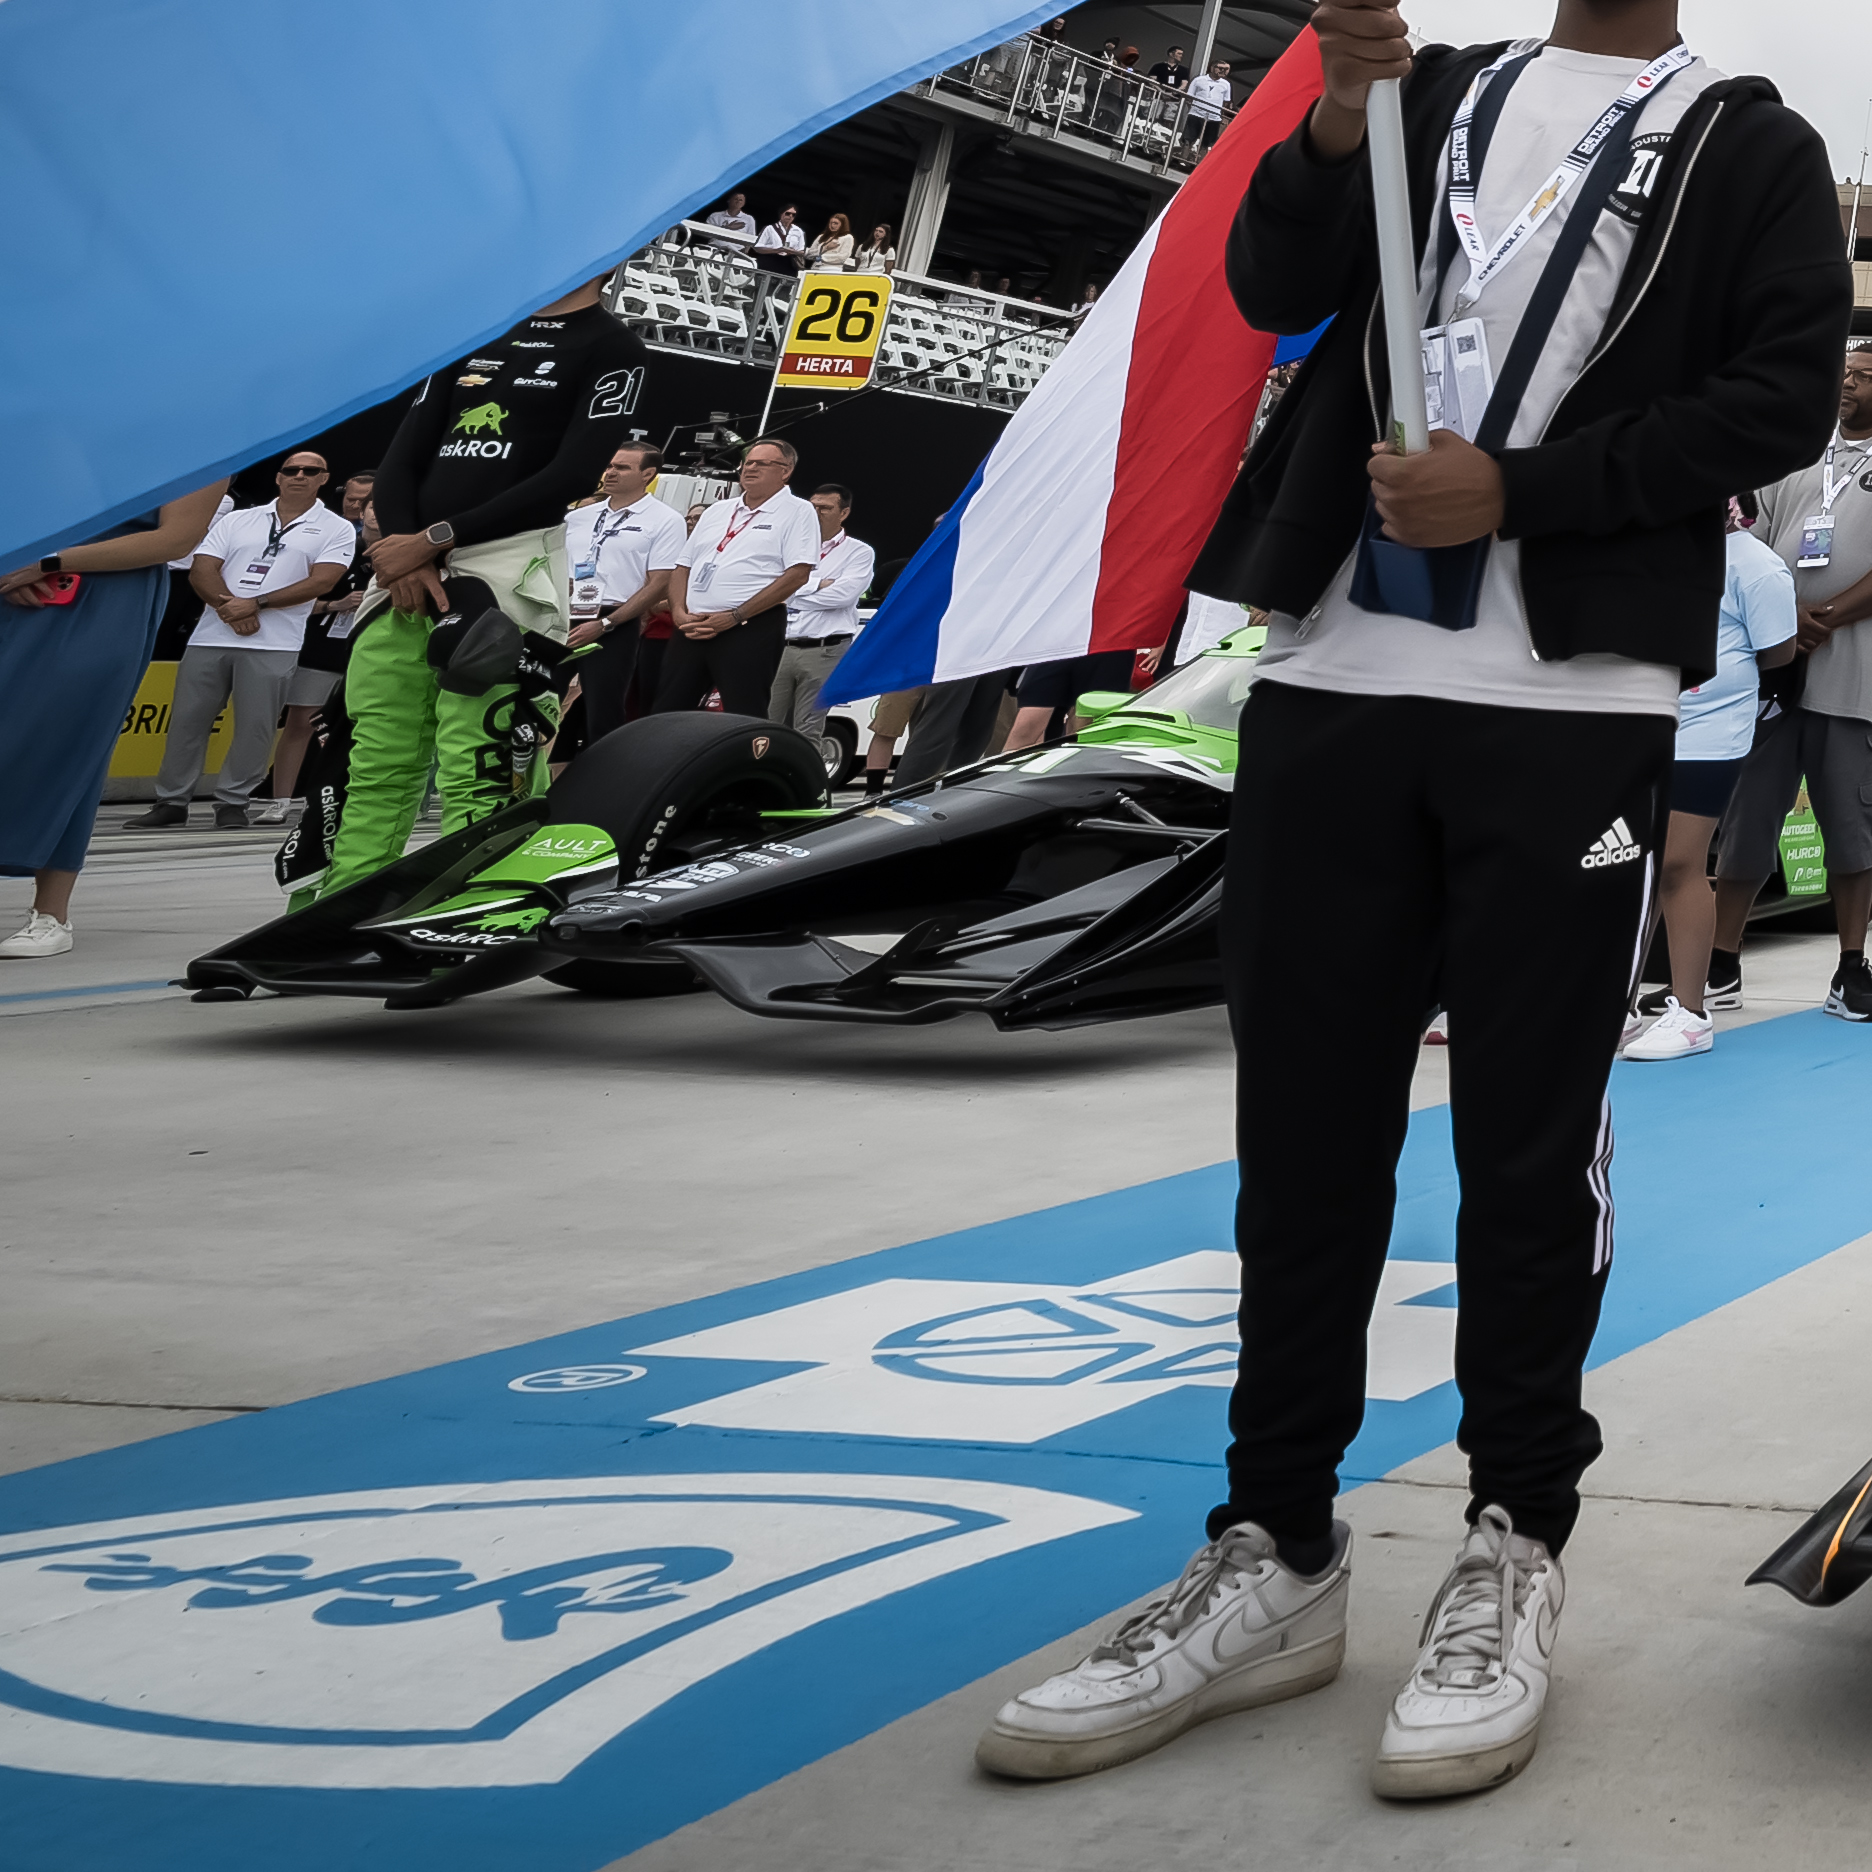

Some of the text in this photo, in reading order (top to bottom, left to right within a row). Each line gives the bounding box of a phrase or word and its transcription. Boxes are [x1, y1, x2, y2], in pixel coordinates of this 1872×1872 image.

[1650, 61, 1670, 77] LEAR
[1577, 107, 1621, 153] DETROIT
[1459, 127, 1470, 182] DETROIT
[1477, 223, 1527, 281] CHEVROLET
[795, 288, 880, 344] 26
[796, 357, 855, 374] HERTA
[588, 366, 645, 419] 21
[439, 439, 512, 459] askROI
[120, 703, 225, 735] BRIE
[530, 849, 592, 860] COMPANY
[533, 836, 609, 853] AULT
[1580, 842, 1642, 869] adidas
[1786, 845, 1822, 861] HURCO
